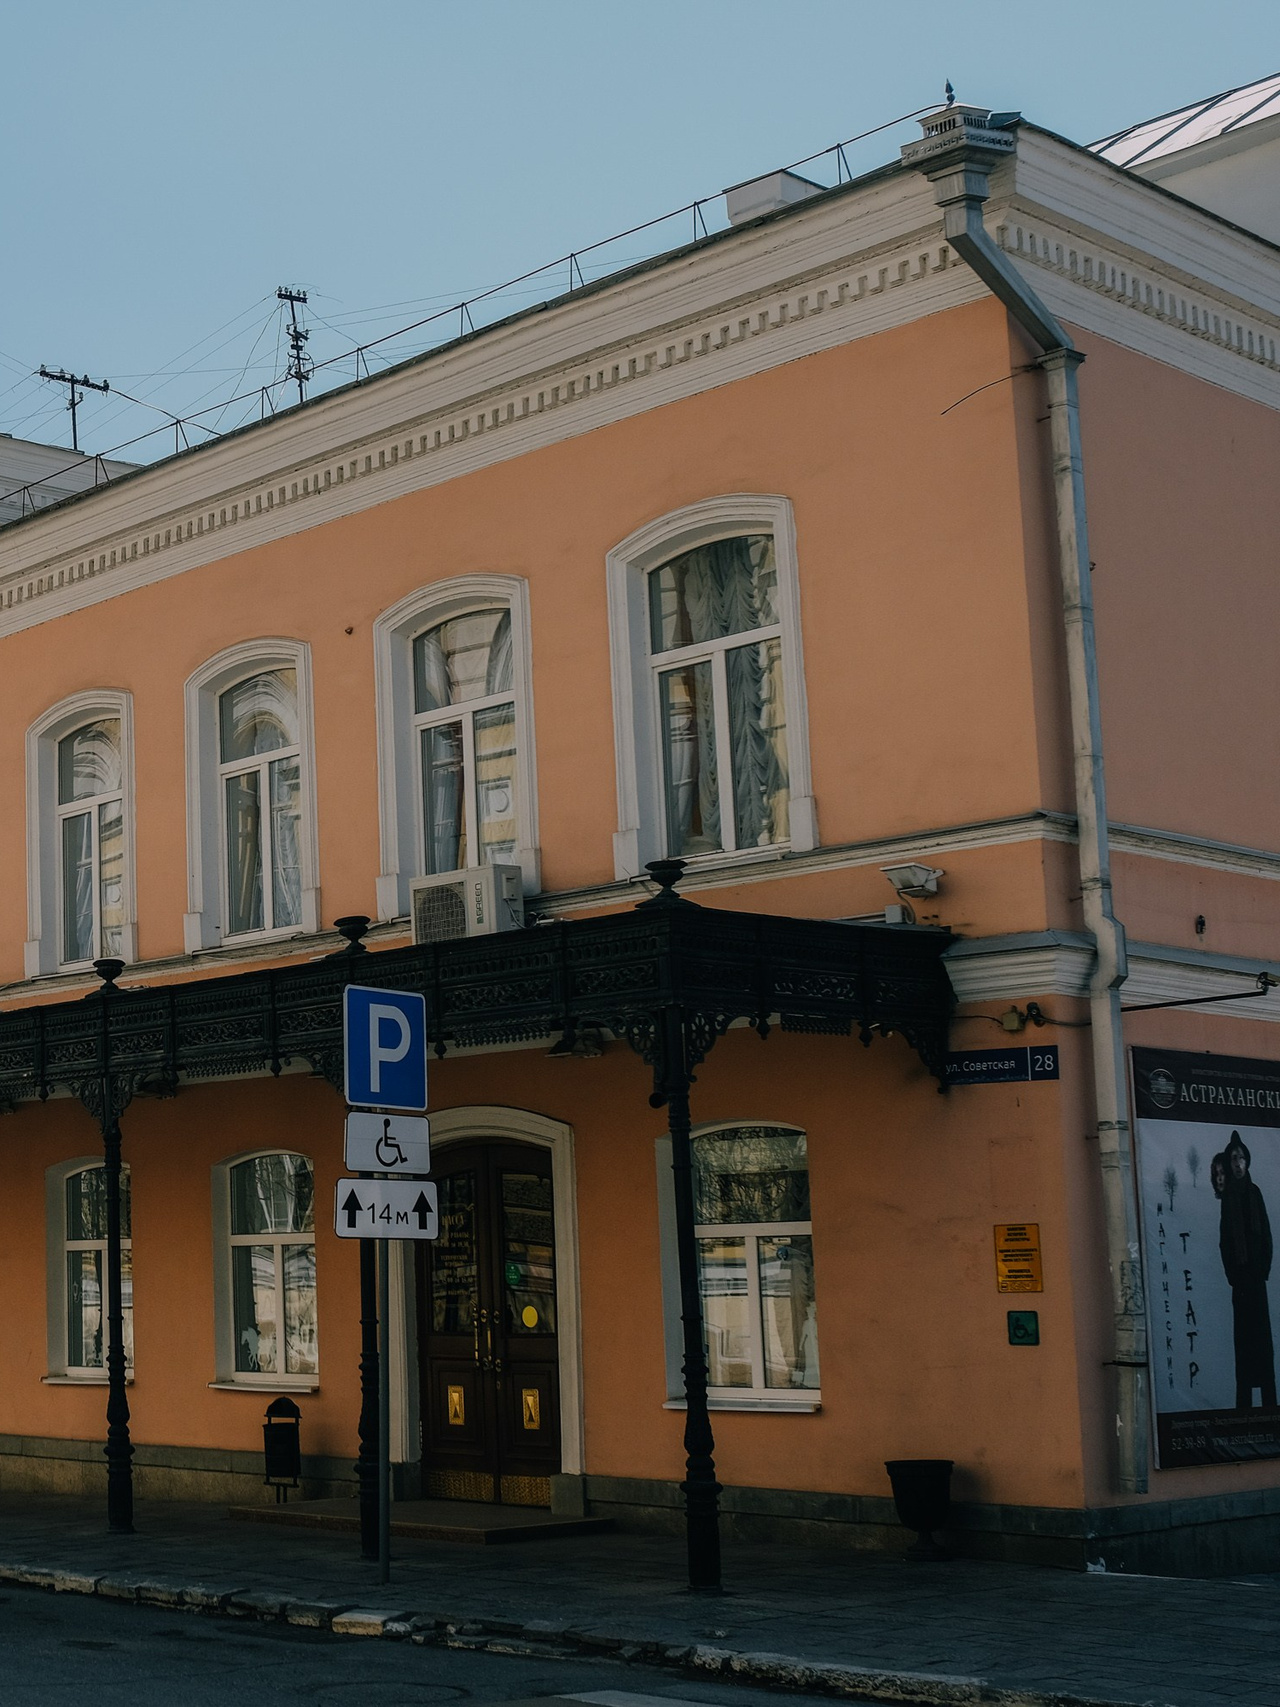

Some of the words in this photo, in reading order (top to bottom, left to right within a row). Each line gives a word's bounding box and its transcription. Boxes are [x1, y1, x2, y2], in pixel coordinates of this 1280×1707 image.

[369, 1003, 411, 1093] P
[945, 1064, 961, 1075] ул.
[962, 1060, 1016, 1072] Советская
[1033, 1054, 1055, 1071] 28
[1179, 1231, 1200, 1389] ТЕАТР
